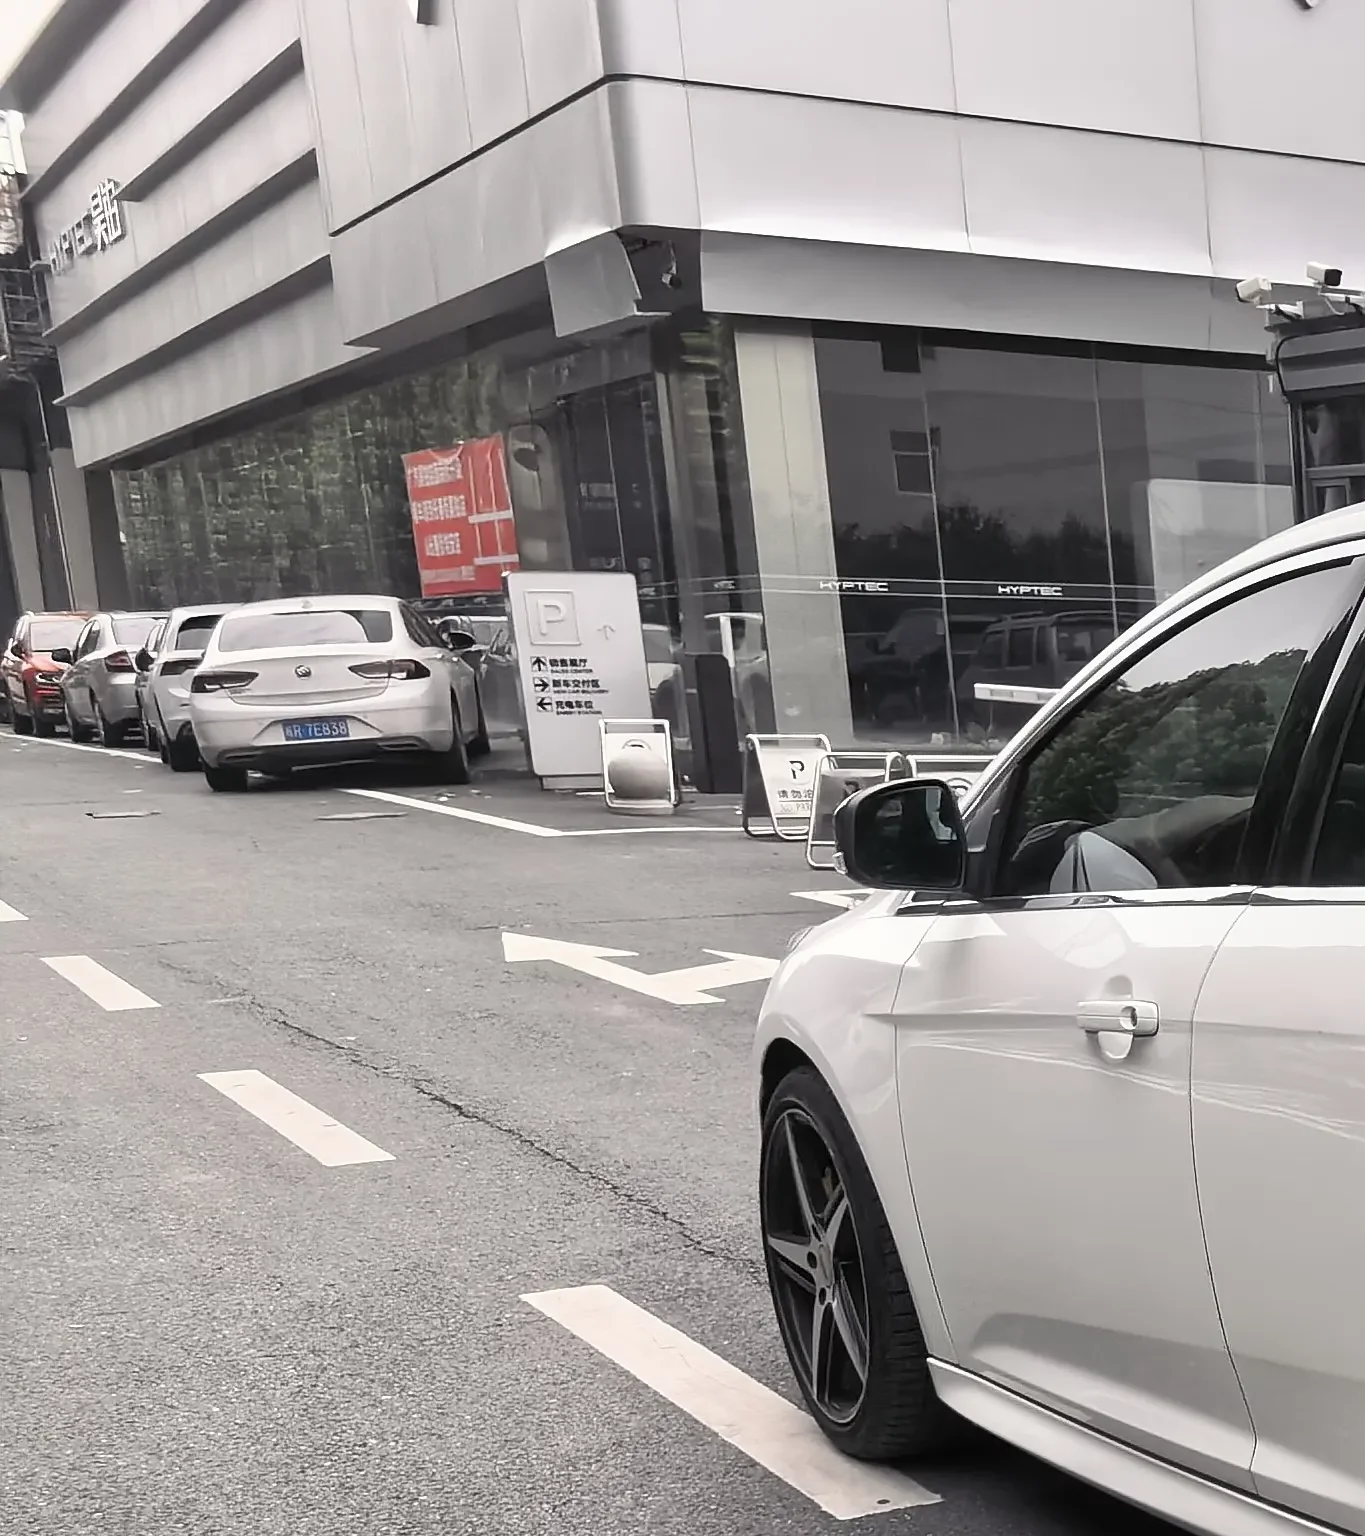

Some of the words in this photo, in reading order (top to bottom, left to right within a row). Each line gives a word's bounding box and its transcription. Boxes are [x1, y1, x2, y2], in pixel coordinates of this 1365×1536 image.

[819, 581, 889, 592] HYPTEC
[997, 585, 1063, 596] HYPTEC
[537, 599, 567, 636] P
